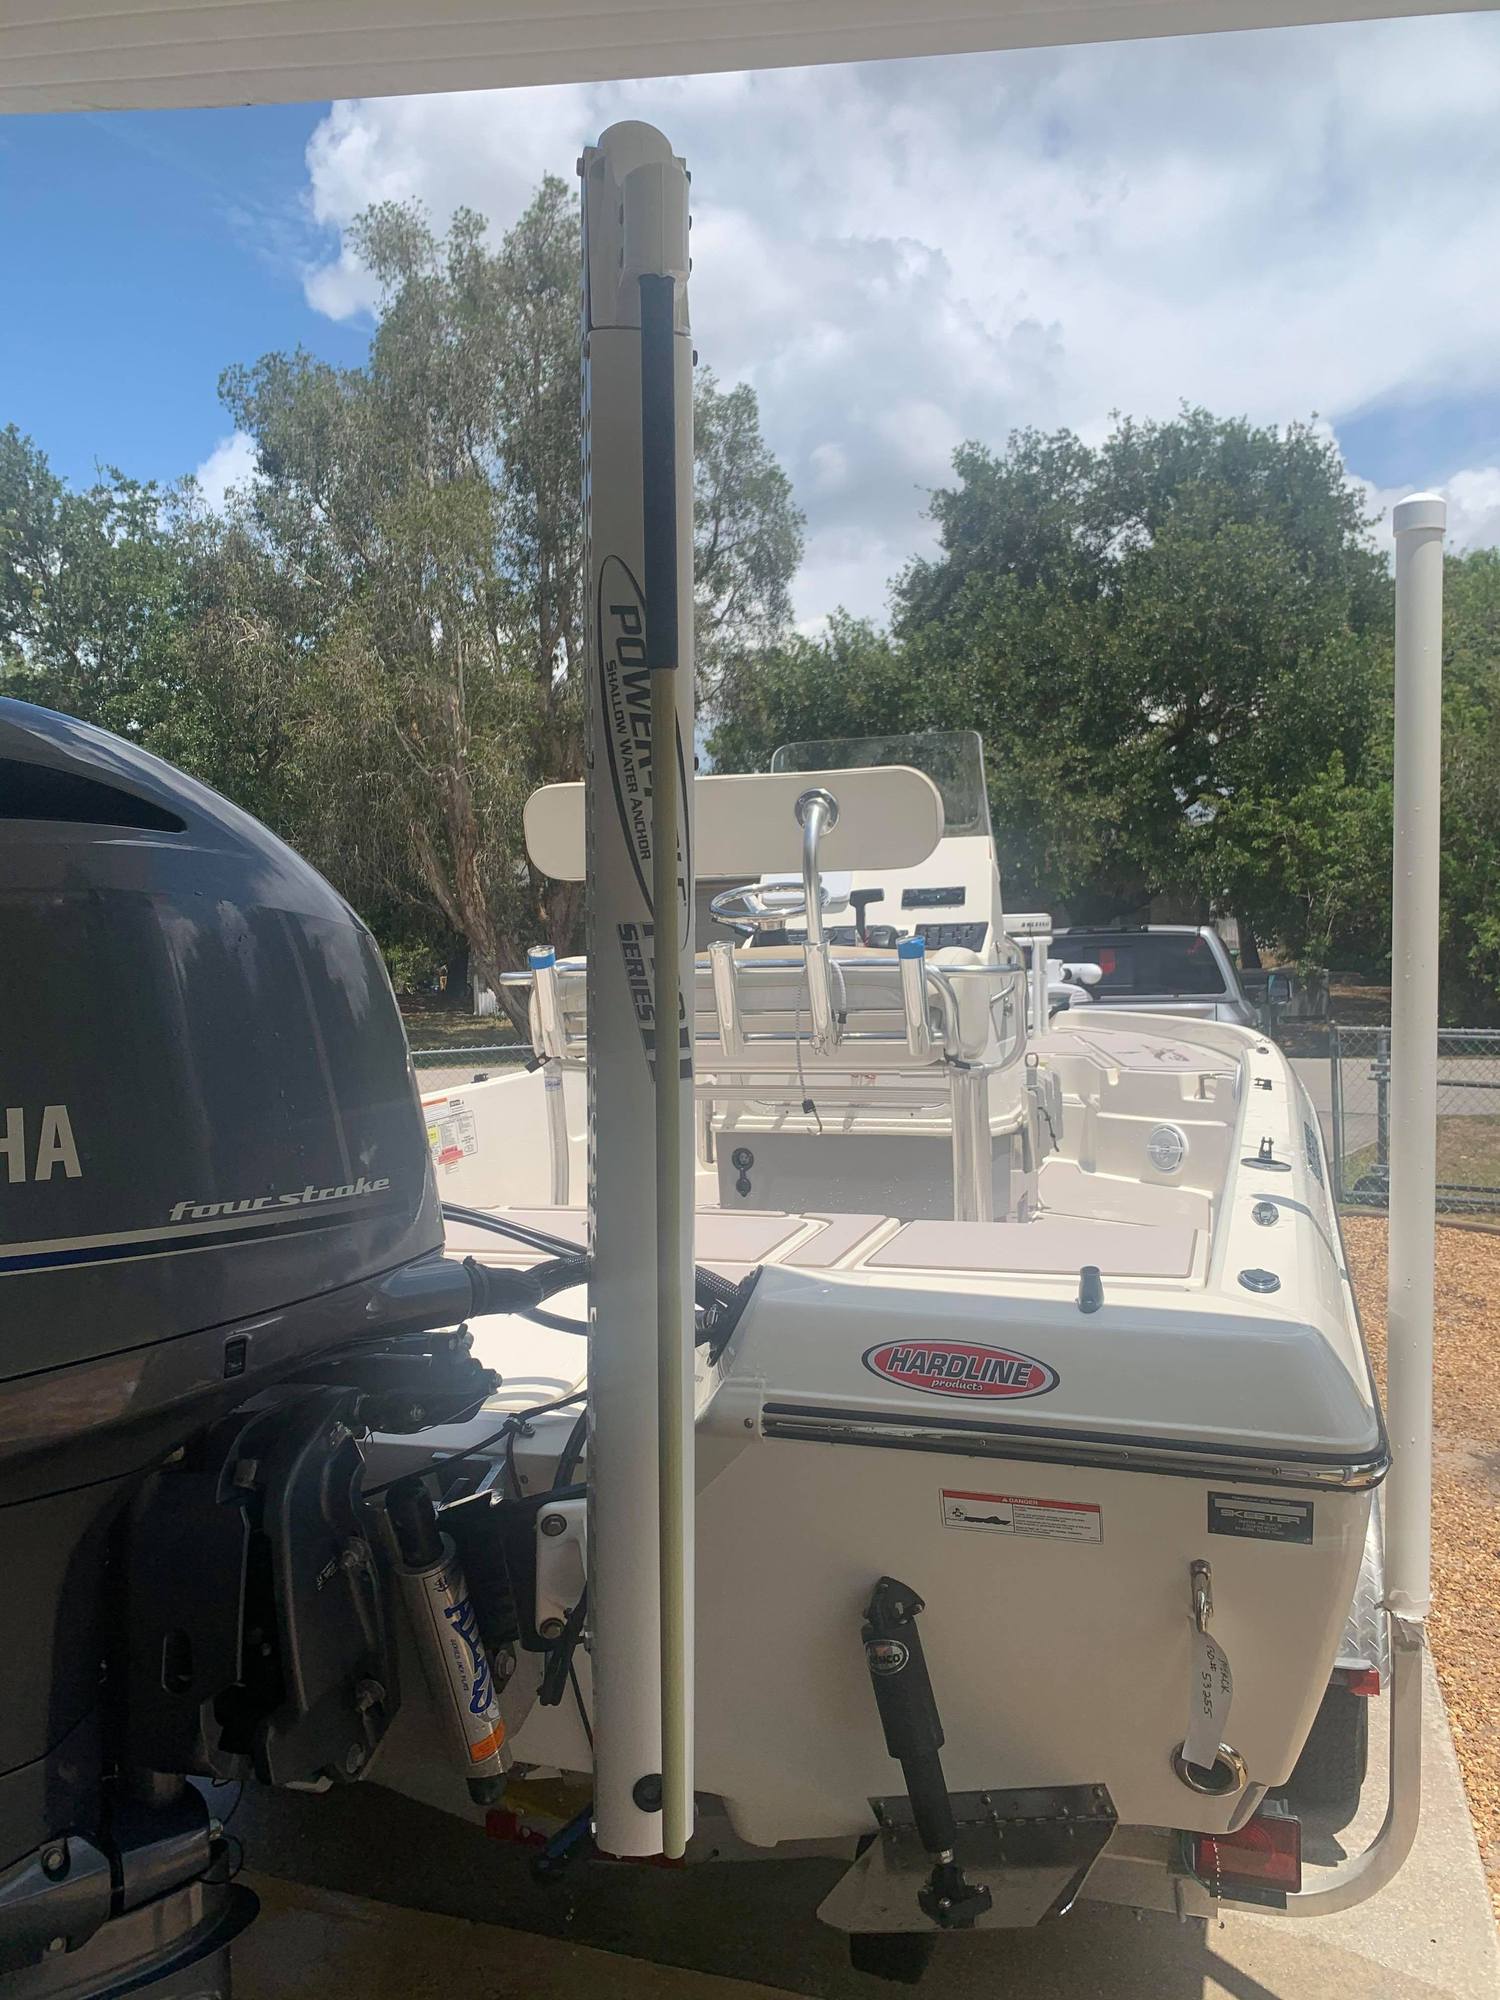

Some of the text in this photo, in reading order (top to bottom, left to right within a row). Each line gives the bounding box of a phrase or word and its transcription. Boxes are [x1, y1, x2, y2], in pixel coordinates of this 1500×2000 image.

[606, 659, 652, 861] SHALLOW WATER ANCHOR
[617, 922, 655, 1021] SERIES
[170, 1176, 391, 1222] four stroke
[886, 1347, 1033, 1388] HARDLINE
[930, 1378, 984, 1392] products
[1220, 1508, 1300, 1525] SKEETER
